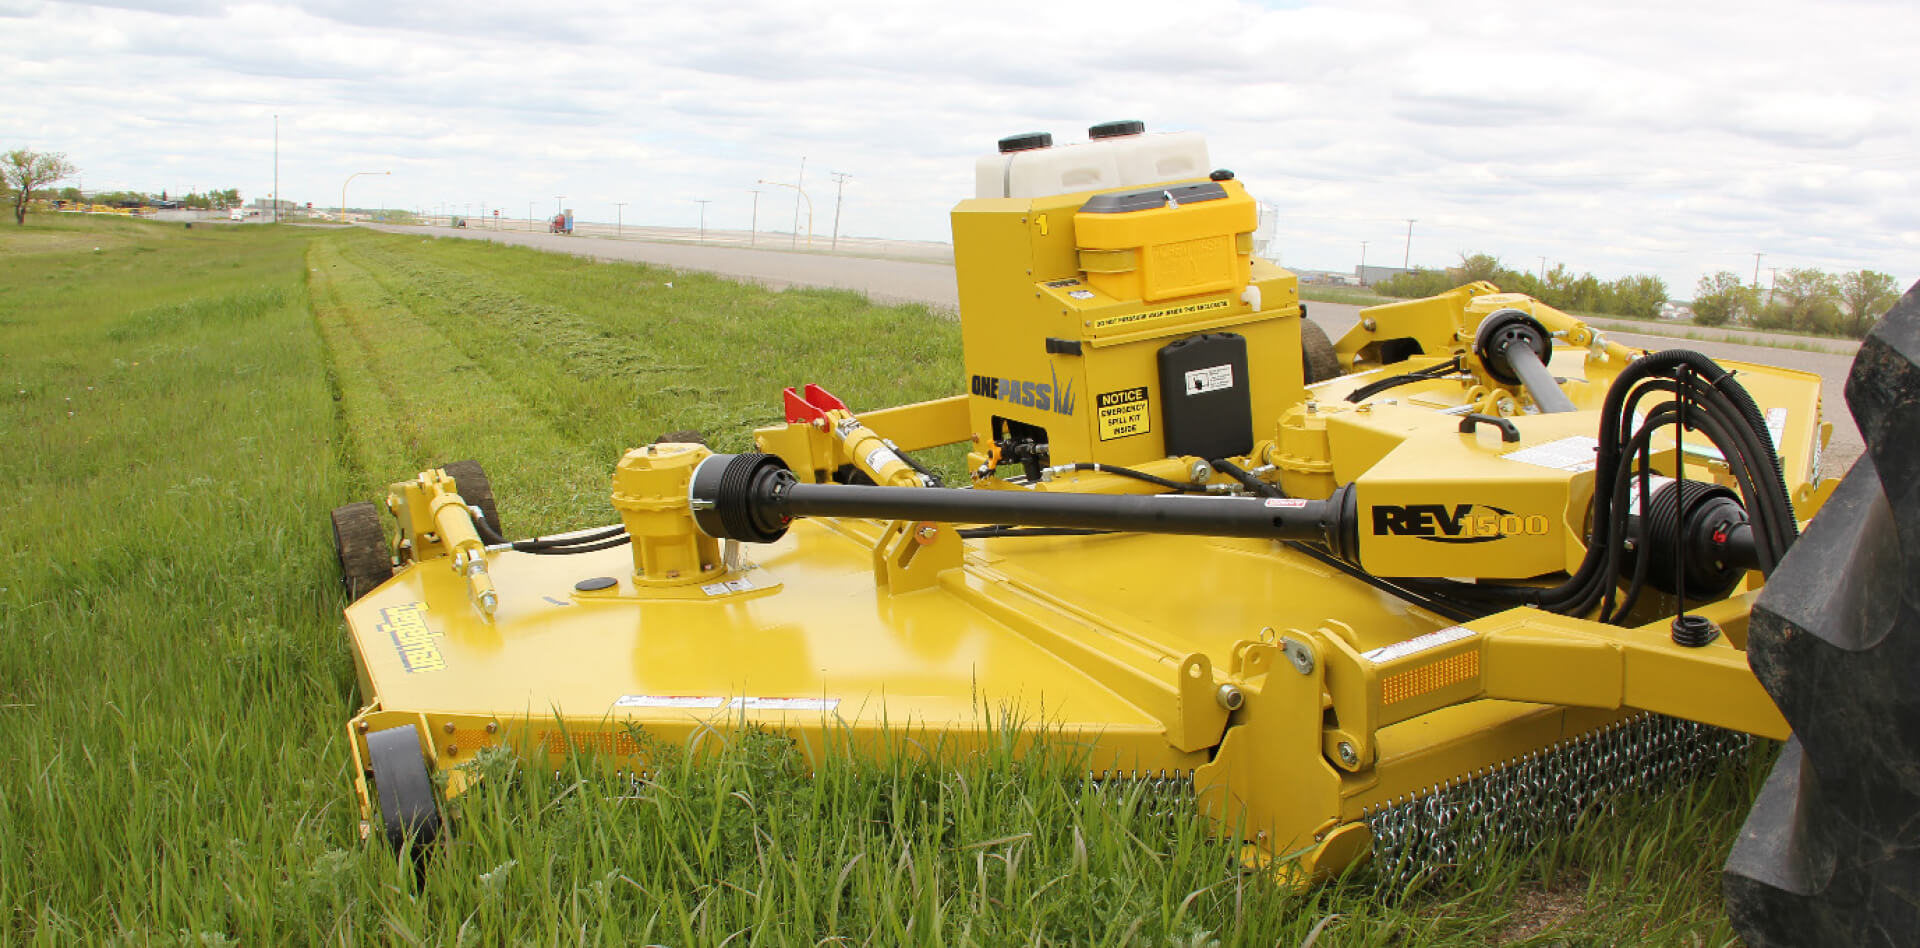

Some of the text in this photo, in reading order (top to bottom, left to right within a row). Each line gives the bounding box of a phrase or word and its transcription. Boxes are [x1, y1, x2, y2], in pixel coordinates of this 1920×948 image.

[1102, 389, 1143, 406] NOTICE
[1101, 403, 1146, 417] EMERGENCY
[1108, 414, 1140, 427] SPILL KIT
[1113, 424, 1137, 435] INSIDE
